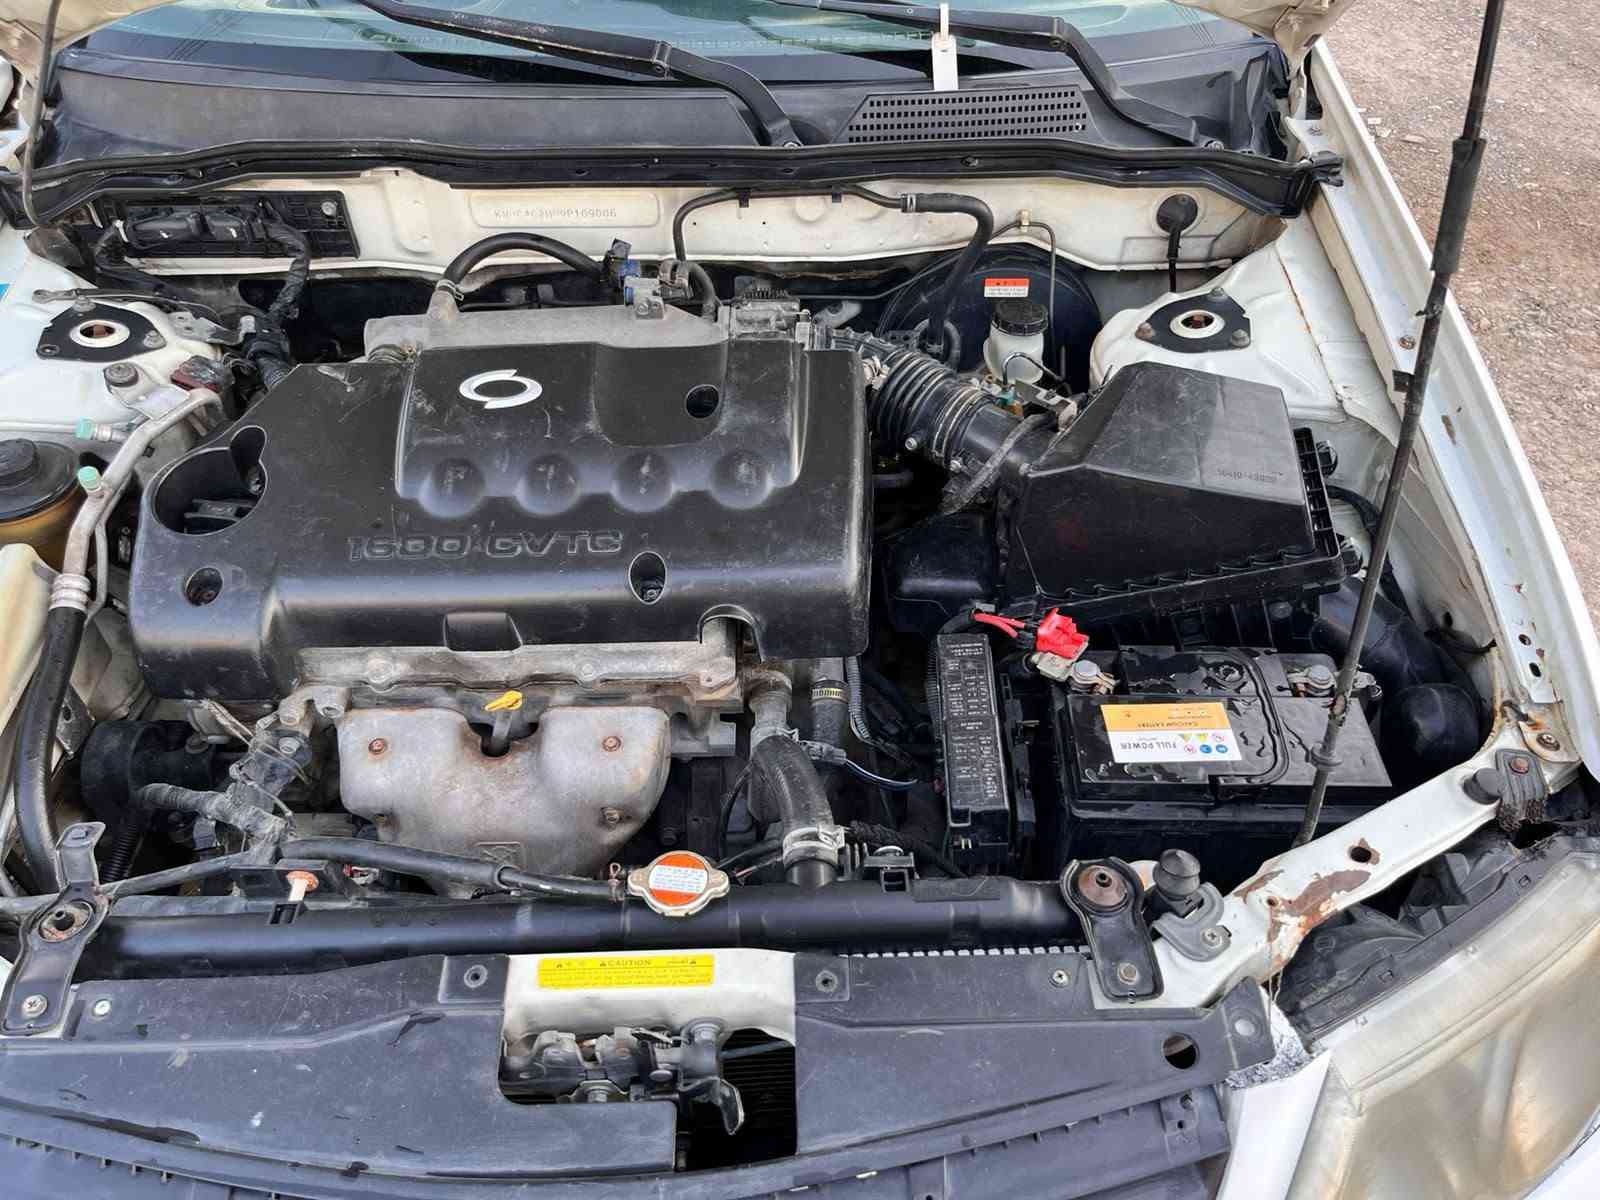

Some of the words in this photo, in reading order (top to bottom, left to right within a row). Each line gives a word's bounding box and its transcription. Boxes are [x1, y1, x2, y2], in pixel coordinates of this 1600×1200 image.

[348, 533, 470, 562] 1600
[1120, 742, 1154, 750] POWER
[1158, 741, 1177, 750] FULL
[607, 959, 652, 967] CAUTION
